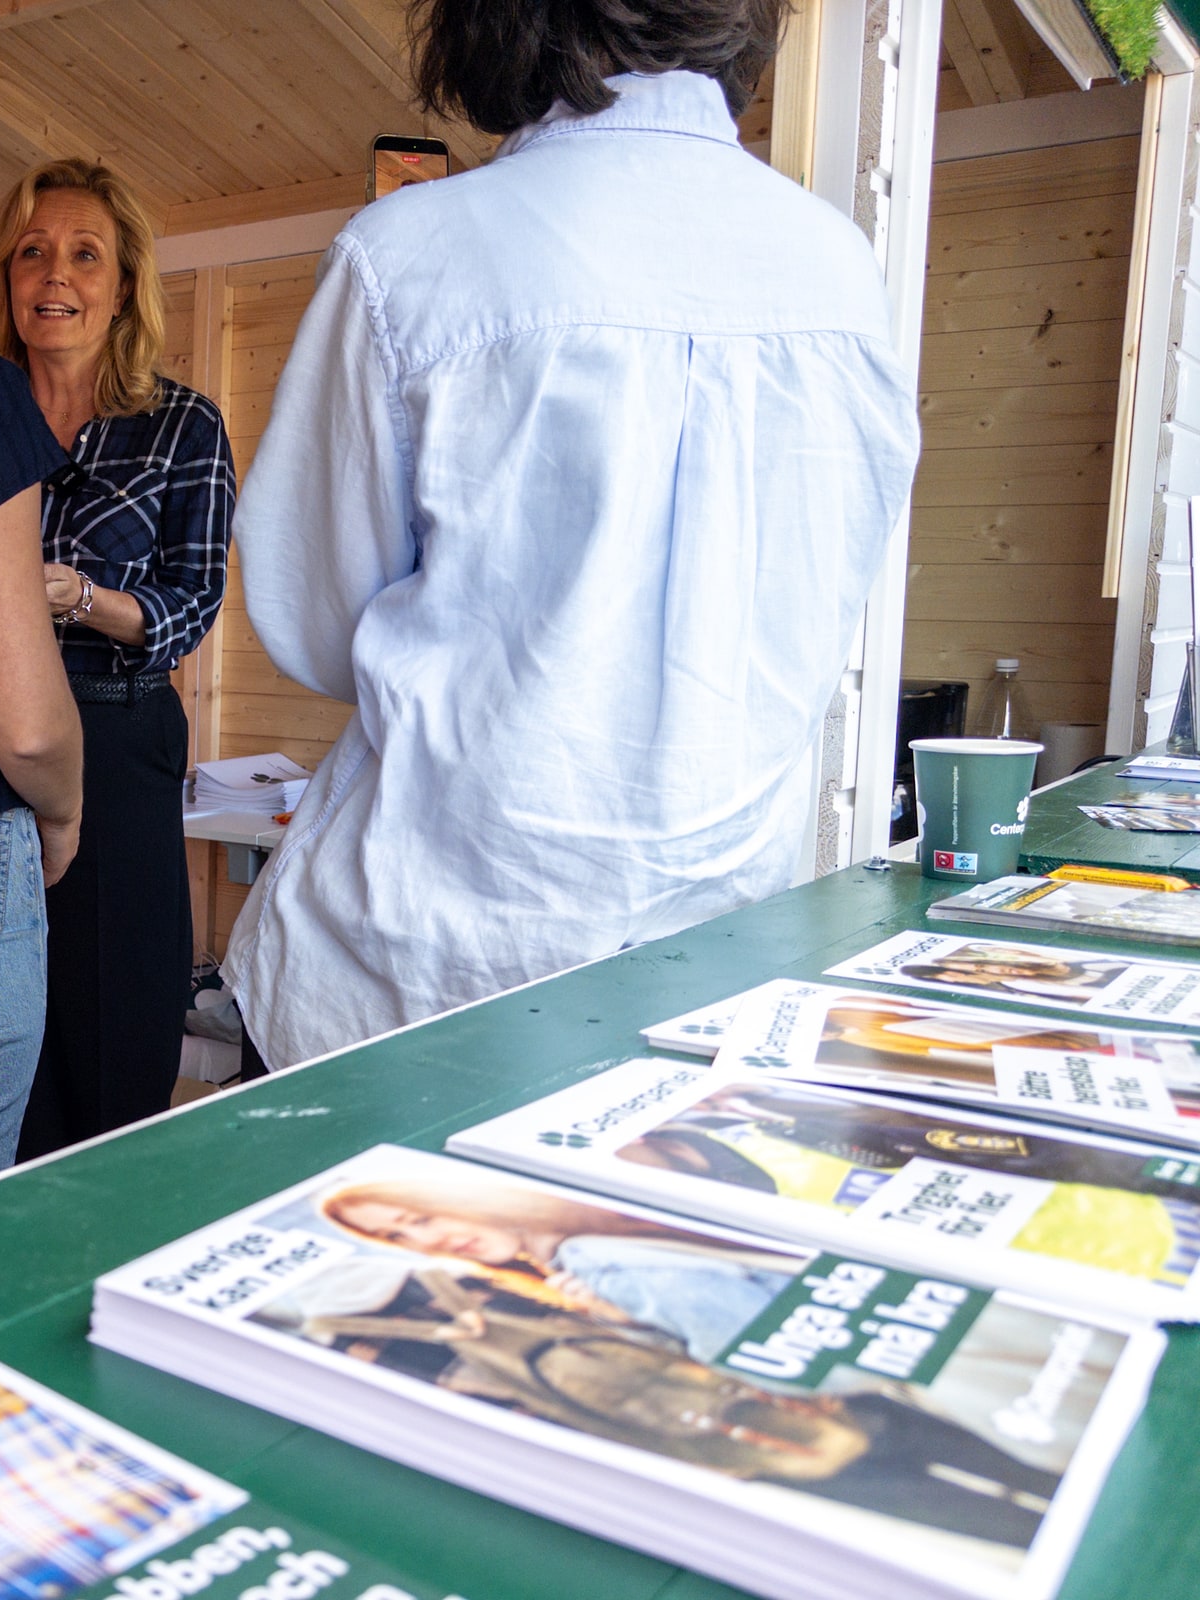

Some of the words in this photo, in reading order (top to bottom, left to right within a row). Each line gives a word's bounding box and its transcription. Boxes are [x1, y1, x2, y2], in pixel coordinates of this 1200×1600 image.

[879, 1169, 969, 1225] Trygghet
[936, 1215, 987, 1239] för
[142, 1232, 275, 1296] Sverige
[186, 1275, 270, 1313] kan
[261, 1239, 328, 1277] mer
[725, 1303, 854, 1380] Unga
[802, 1261, 887, 1311] ska
[873, 1278, 970, 1332] bra
[854, 1318, 939, 1379] må
